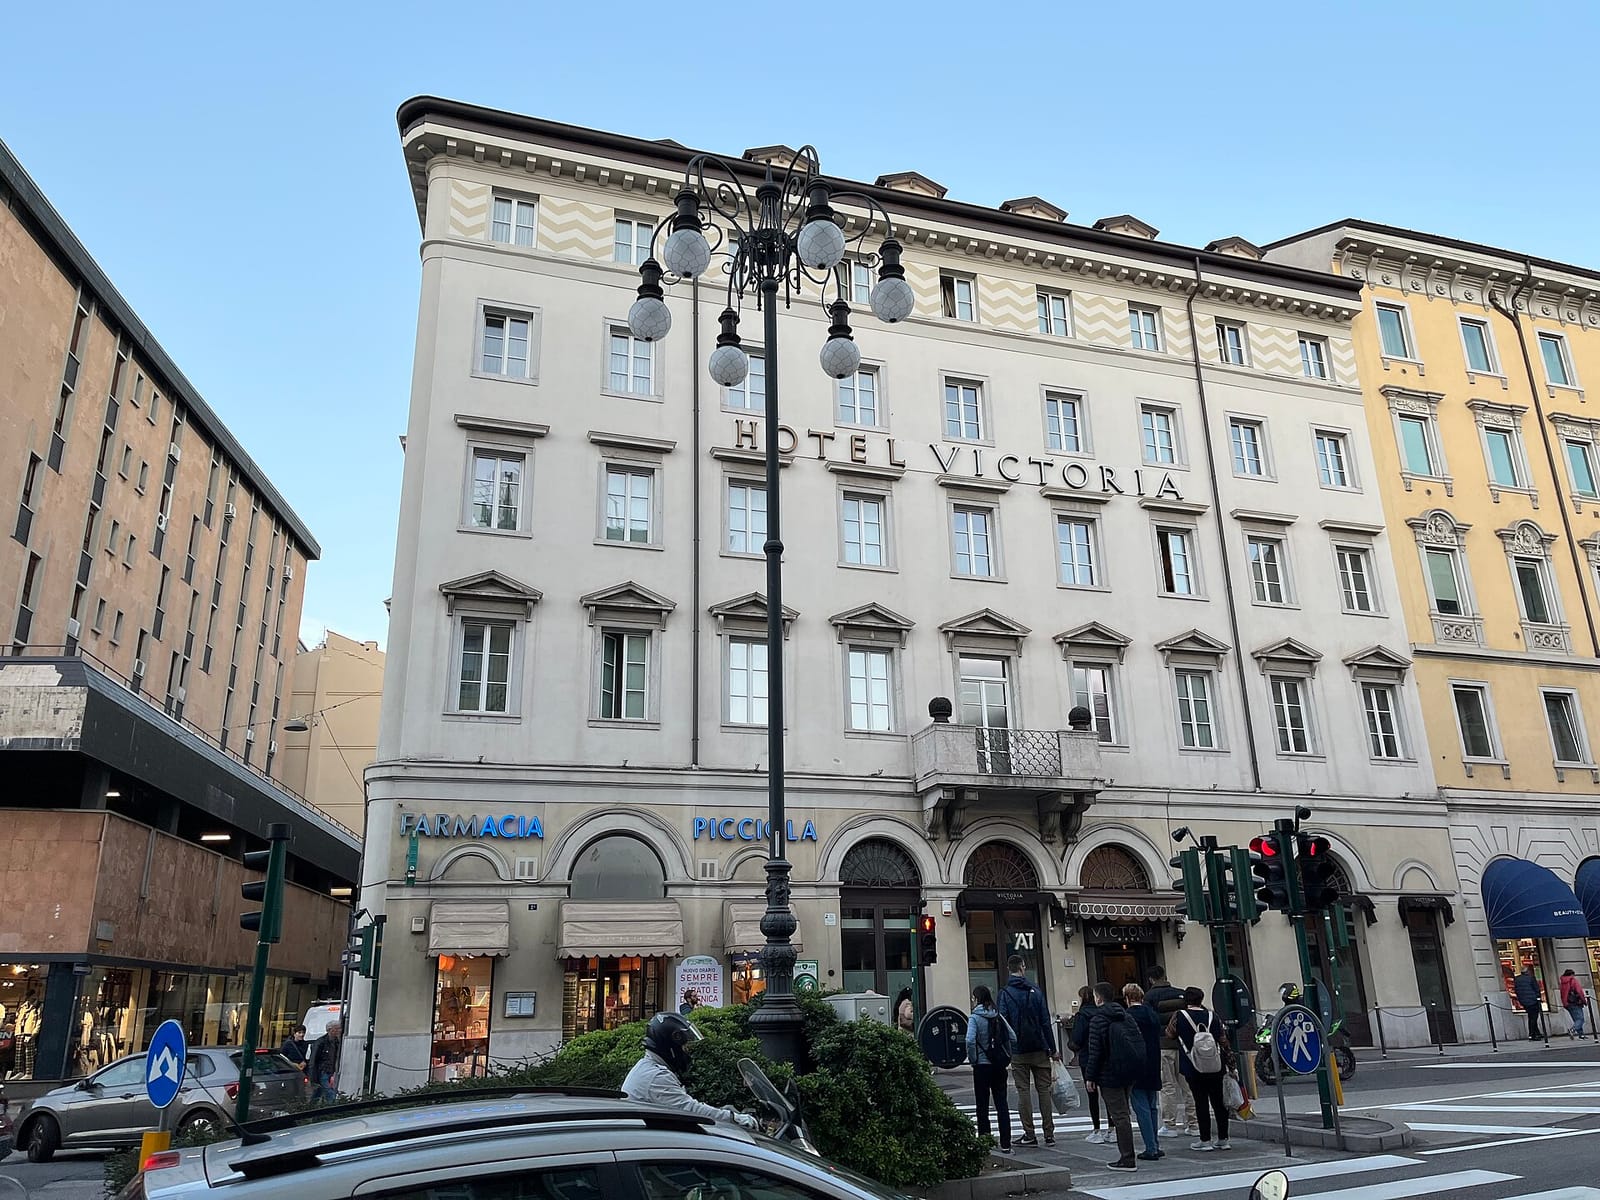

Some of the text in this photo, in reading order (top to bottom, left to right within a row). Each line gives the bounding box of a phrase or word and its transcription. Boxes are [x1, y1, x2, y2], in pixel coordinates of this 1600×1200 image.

[735, 419, 1184, 500] HOTEL VICTORIA
[400, 813, 544, 838] FARMACIA
[693, 816, 818, 841] PICCILA
[680, 974, 718, 982] SEMPRE
[680, 995, 718, 1003] DNICA
